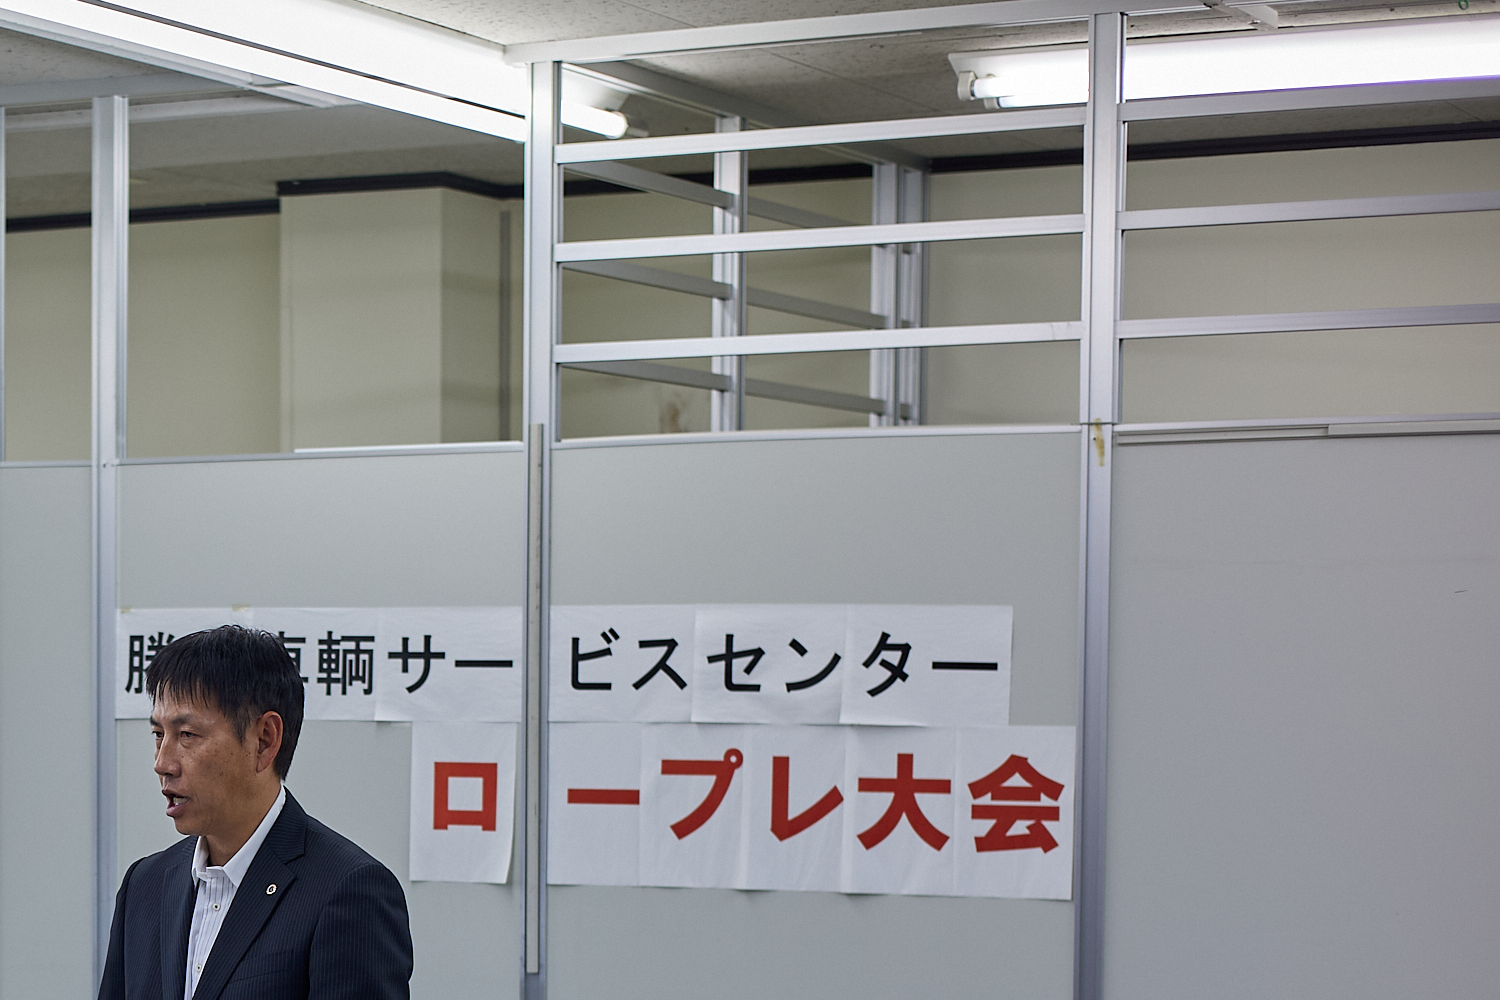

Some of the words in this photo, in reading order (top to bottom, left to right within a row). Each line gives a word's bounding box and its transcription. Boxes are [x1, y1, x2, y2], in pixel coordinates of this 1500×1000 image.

[434, 749, 1063, 852] ロープレ大会
